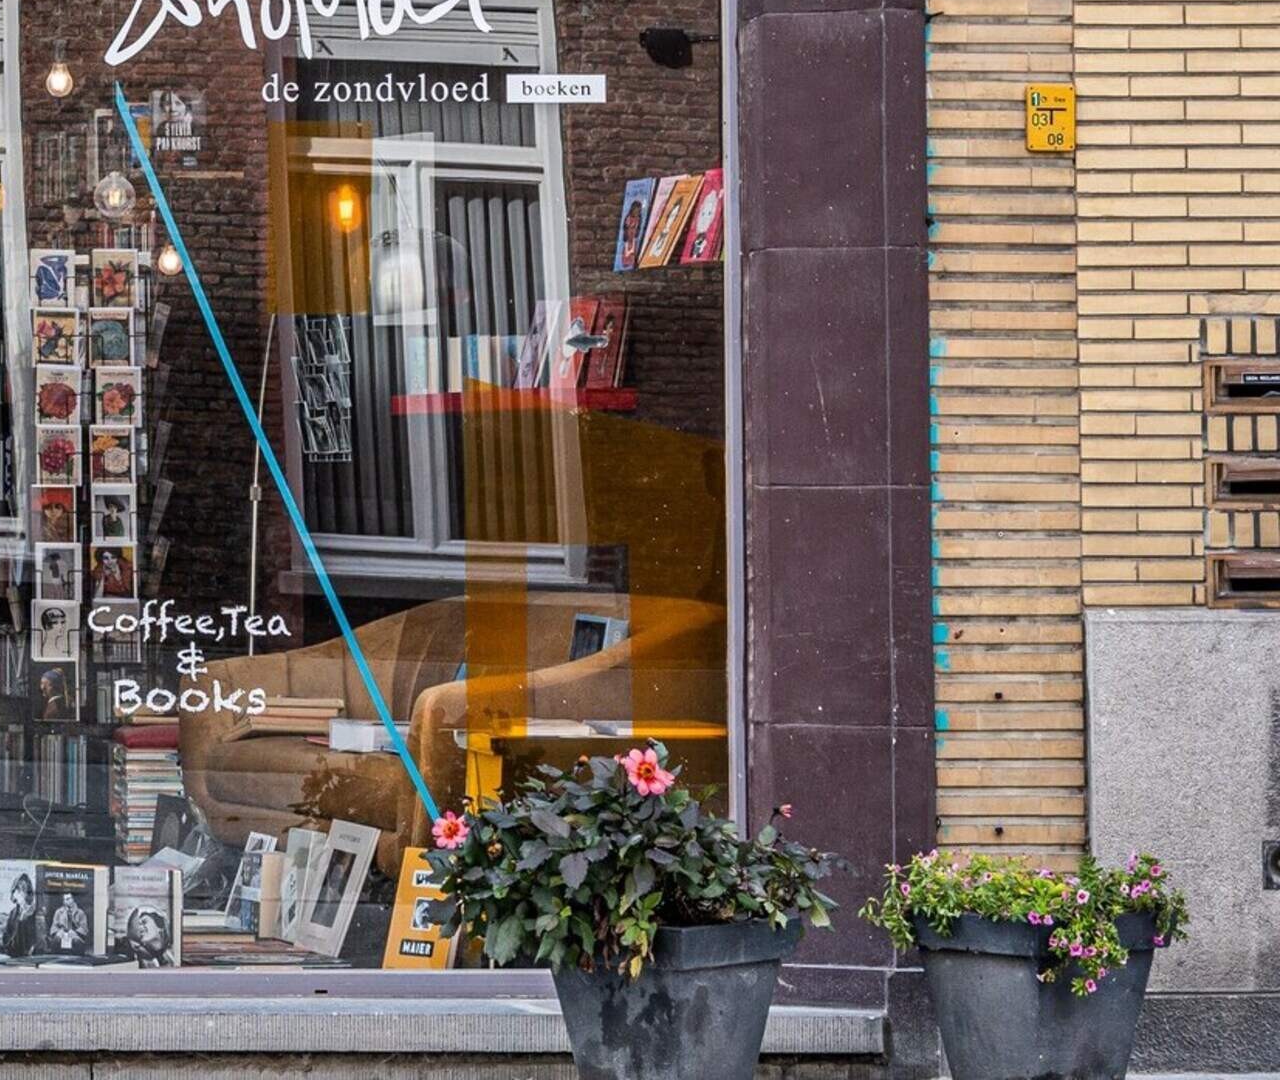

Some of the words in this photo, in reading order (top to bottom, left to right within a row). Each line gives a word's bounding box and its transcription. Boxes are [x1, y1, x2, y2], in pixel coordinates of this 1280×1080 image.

[262, 73, 300, 103] de
[313, 73, 490, 103] zondvloed
[521, 79, 592, 97] boeken
[1032, 113, 1048, 126] 03
[1047, 133, 1064, 145] 08
[176, 641, 208, 682] &
[113, 679, 267, 715] Books
[402, 941, 431, 952] MAIER
